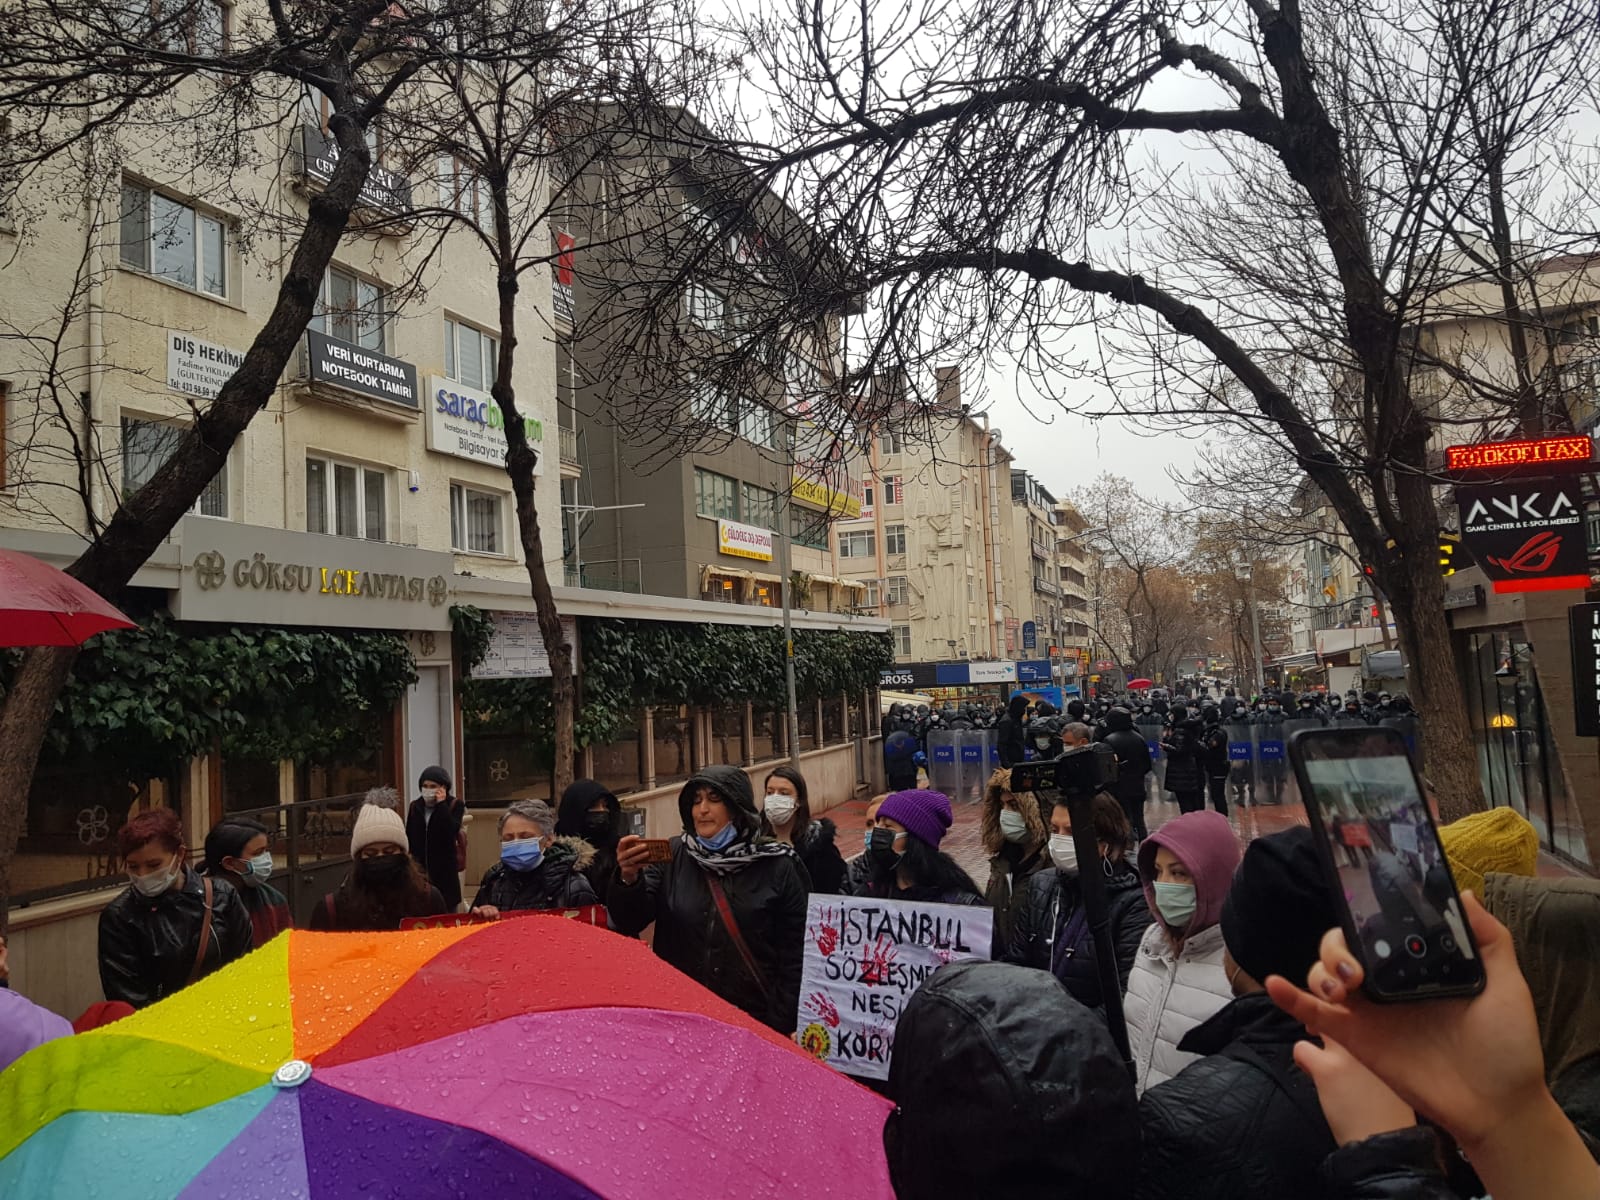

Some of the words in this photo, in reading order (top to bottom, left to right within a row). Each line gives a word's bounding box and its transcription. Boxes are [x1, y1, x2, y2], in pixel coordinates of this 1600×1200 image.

[173, 336, 195, 358] DİŞ
[178, 357, 204, 372] Fadime
[326, 343, 351, 362] VERİ
[353, 352, 405, 380] KURTARMA
[177, 367, 223, 388] (GÜLTEKİNO
[321, 360, 379, 389] NOTEBOOK
[380, 379, 412, 399] TAMİRİ
[458, 436, 499, 460] Bilgisayar
[1546, 442, 1584, 458] FAX
[1466, 491, 1578, 524] ANKA
[1466, 524, 1486, 533] GAME
[1487, 521, 1515, 531] CENTER
[1516, 520, 1522, 529] &
[1523, 518, 1549, 528] E-SPOR
[233, 552, 313, 592] GÖKSU
[319, 567, 425, 602] LOKANTASI
[840, 902, 972, 953] İSTANBUL
